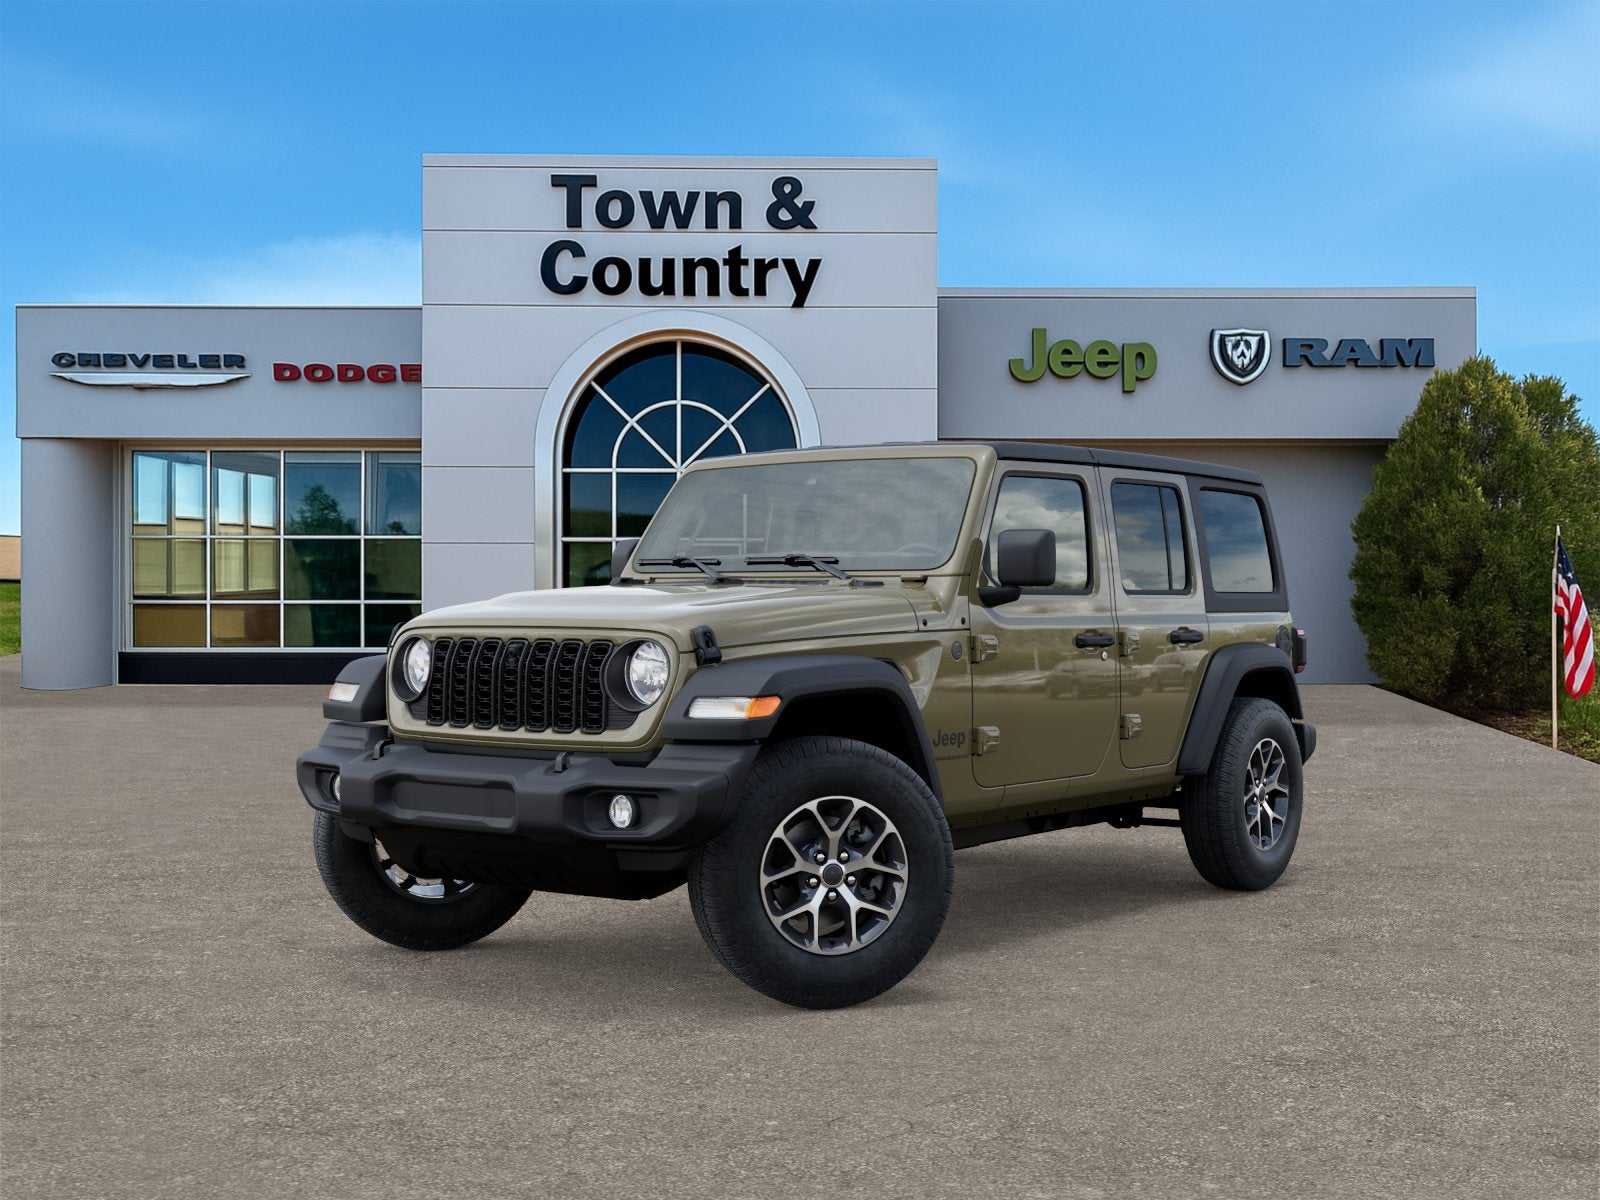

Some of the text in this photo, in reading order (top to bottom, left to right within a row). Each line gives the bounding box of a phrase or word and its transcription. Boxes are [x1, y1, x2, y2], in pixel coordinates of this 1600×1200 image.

[550, 174, 818, 230] Town &
[539, 239, 823, 308] Country
[272, 362, 422, 384] DODGE
[1009, 327, 1158, 393] Jeep
[1282, 337, 1436, 368] RAM
[932, 728, 966, 748] Jeep
